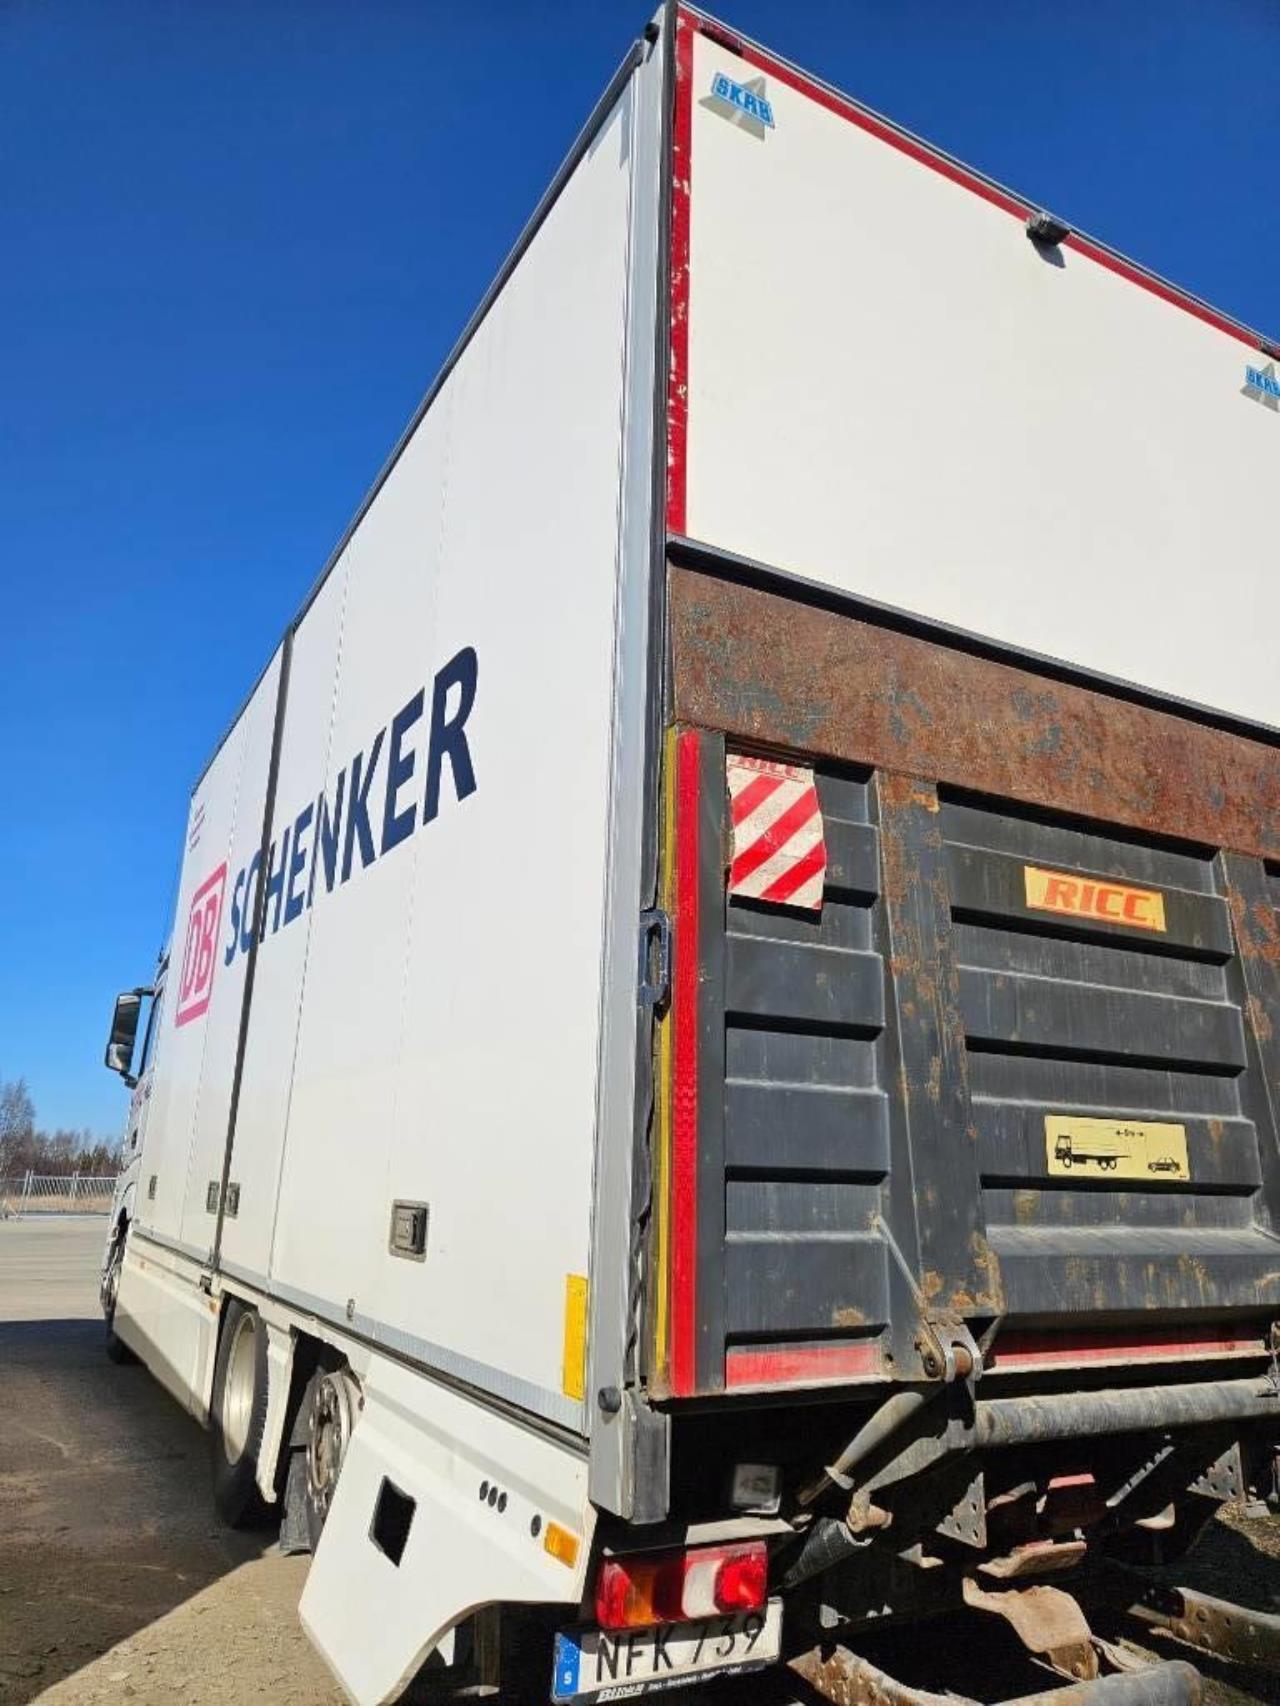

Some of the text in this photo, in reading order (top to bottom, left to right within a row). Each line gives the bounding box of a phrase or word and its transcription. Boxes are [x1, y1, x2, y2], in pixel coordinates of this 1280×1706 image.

[181, 646, 479, 1004] DB SCHENKER
[1044, 877, 1151, 921] RICC
[596, 1624, 674, 1682] NFK
[691, 1612, 768, 1665] 739
[563, 1669, 573, 1686] S
